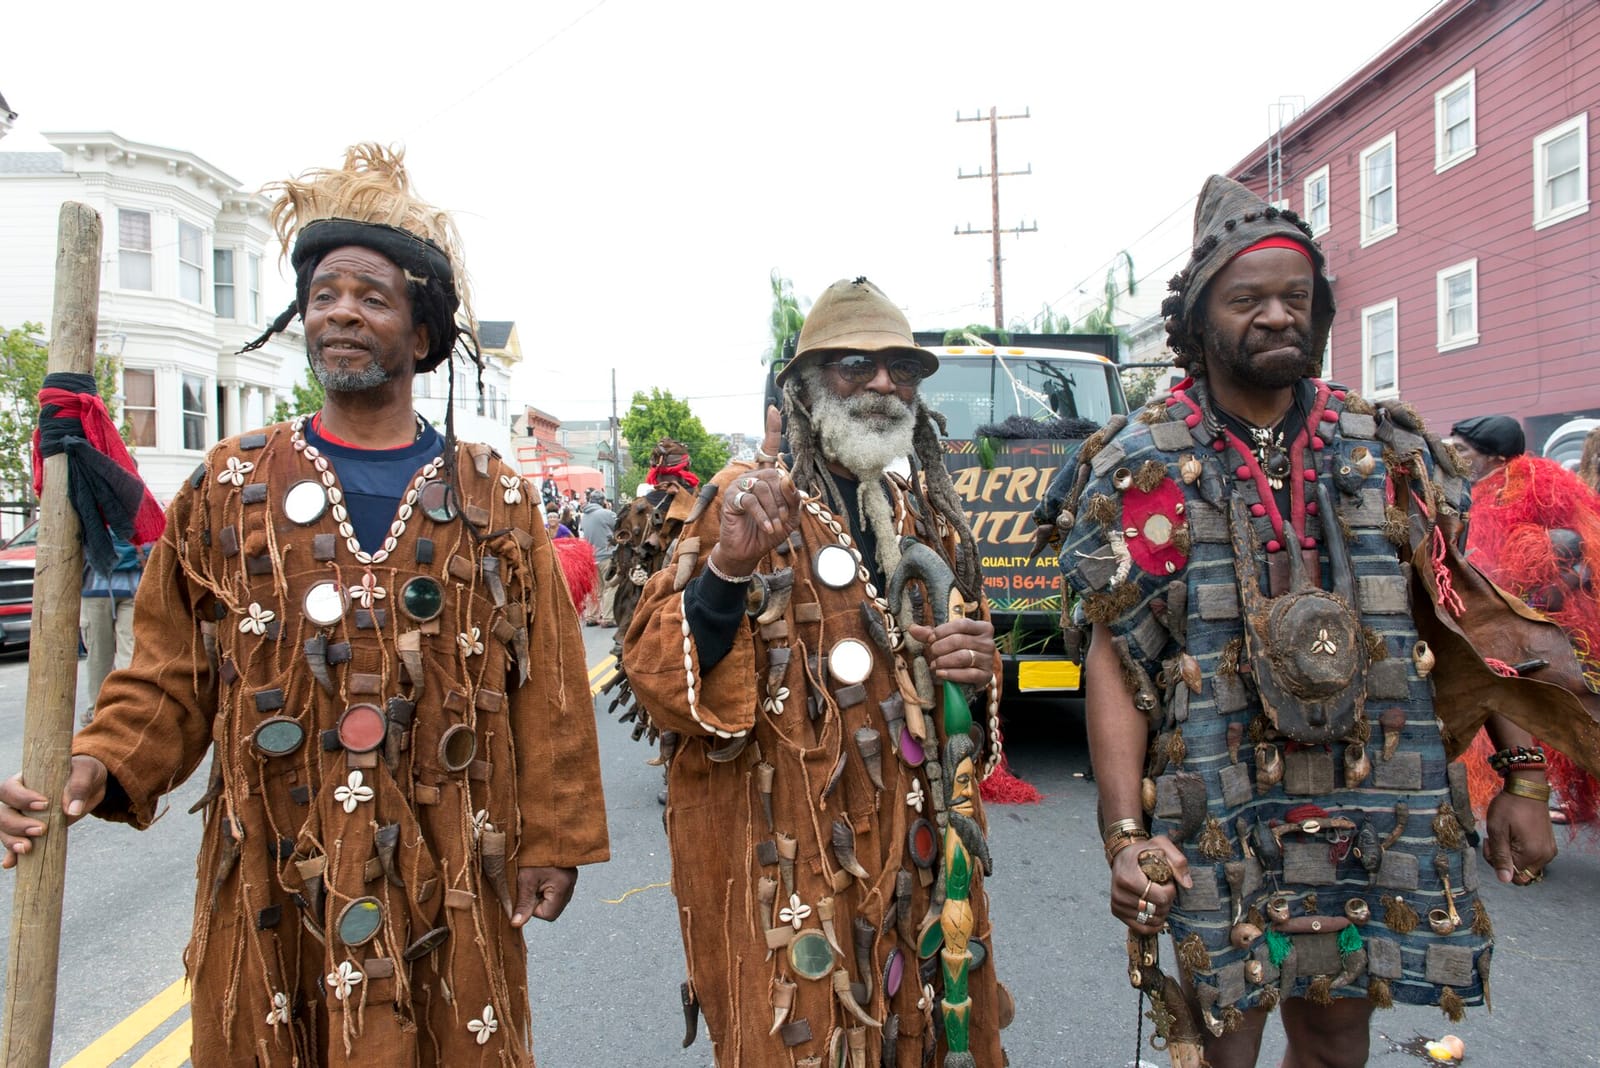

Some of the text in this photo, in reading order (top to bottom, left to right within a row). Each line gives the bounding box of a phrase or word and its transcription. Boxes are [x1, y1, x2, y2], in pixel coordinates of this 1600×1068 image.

[951, 466, 1058, 502] AFRI
[981, 556, 1060, 568] QUALITY AFR
[1013, 575, 1061, 590] 864-E
